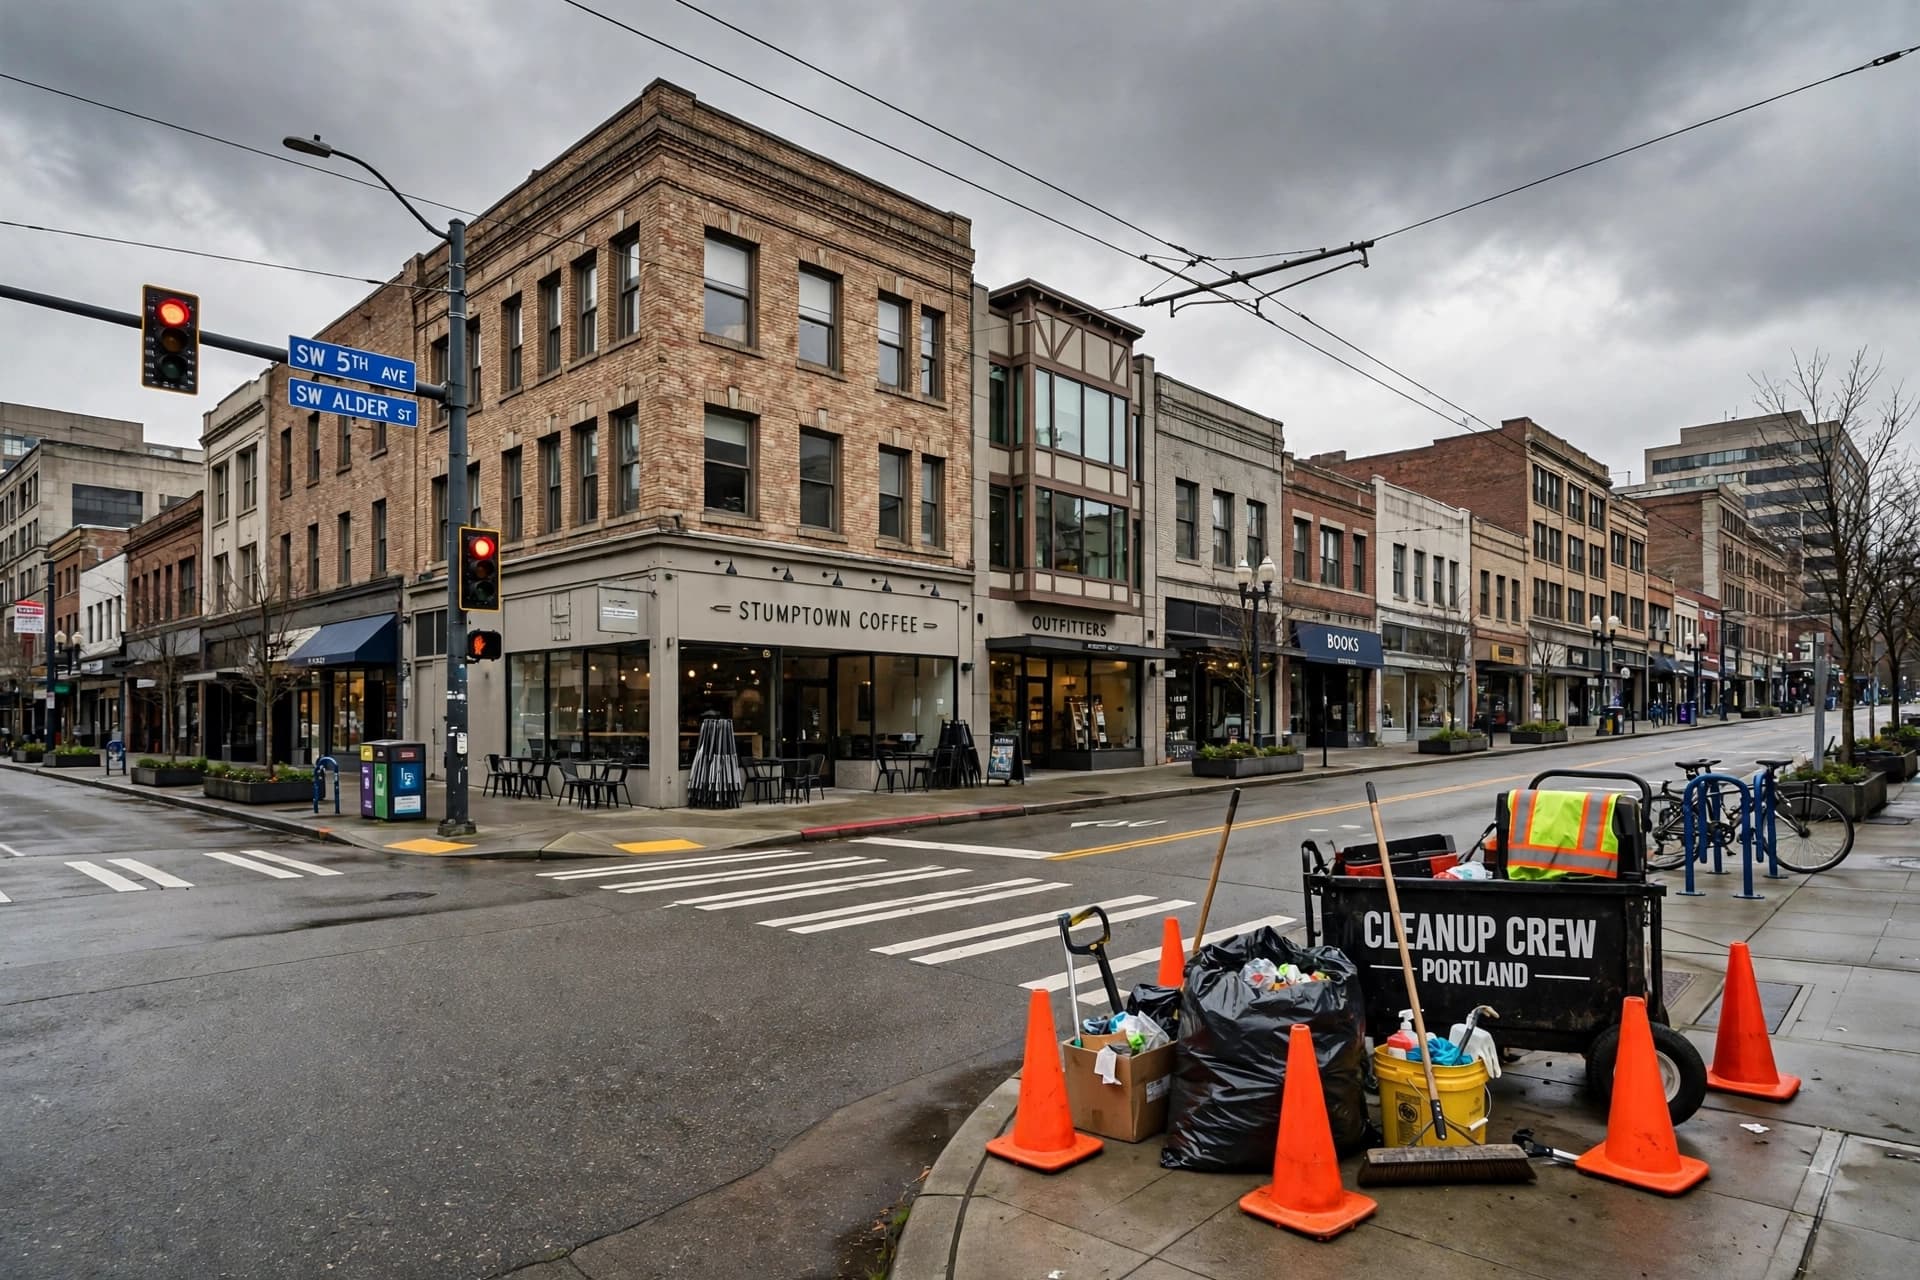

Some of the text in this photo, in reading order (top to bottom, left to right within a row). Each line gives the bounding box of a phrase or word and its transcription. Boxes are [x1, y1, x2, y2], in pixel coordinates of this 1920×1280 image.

[296, 344, 408, 384] SW 5TH AVE
[296, 385, 412, 422] SW ALDER ST
[739, 600, 918, 633] STUMPTOWN COFFEE
[1032, 615, 1107, 637] OUTFITTERS
[1327, 633, 1359, 652] BOOKS
[1363, 910, 1597, 959] CLEANUP CREW
[1422, 958, 1529, 988] PORTLAND
